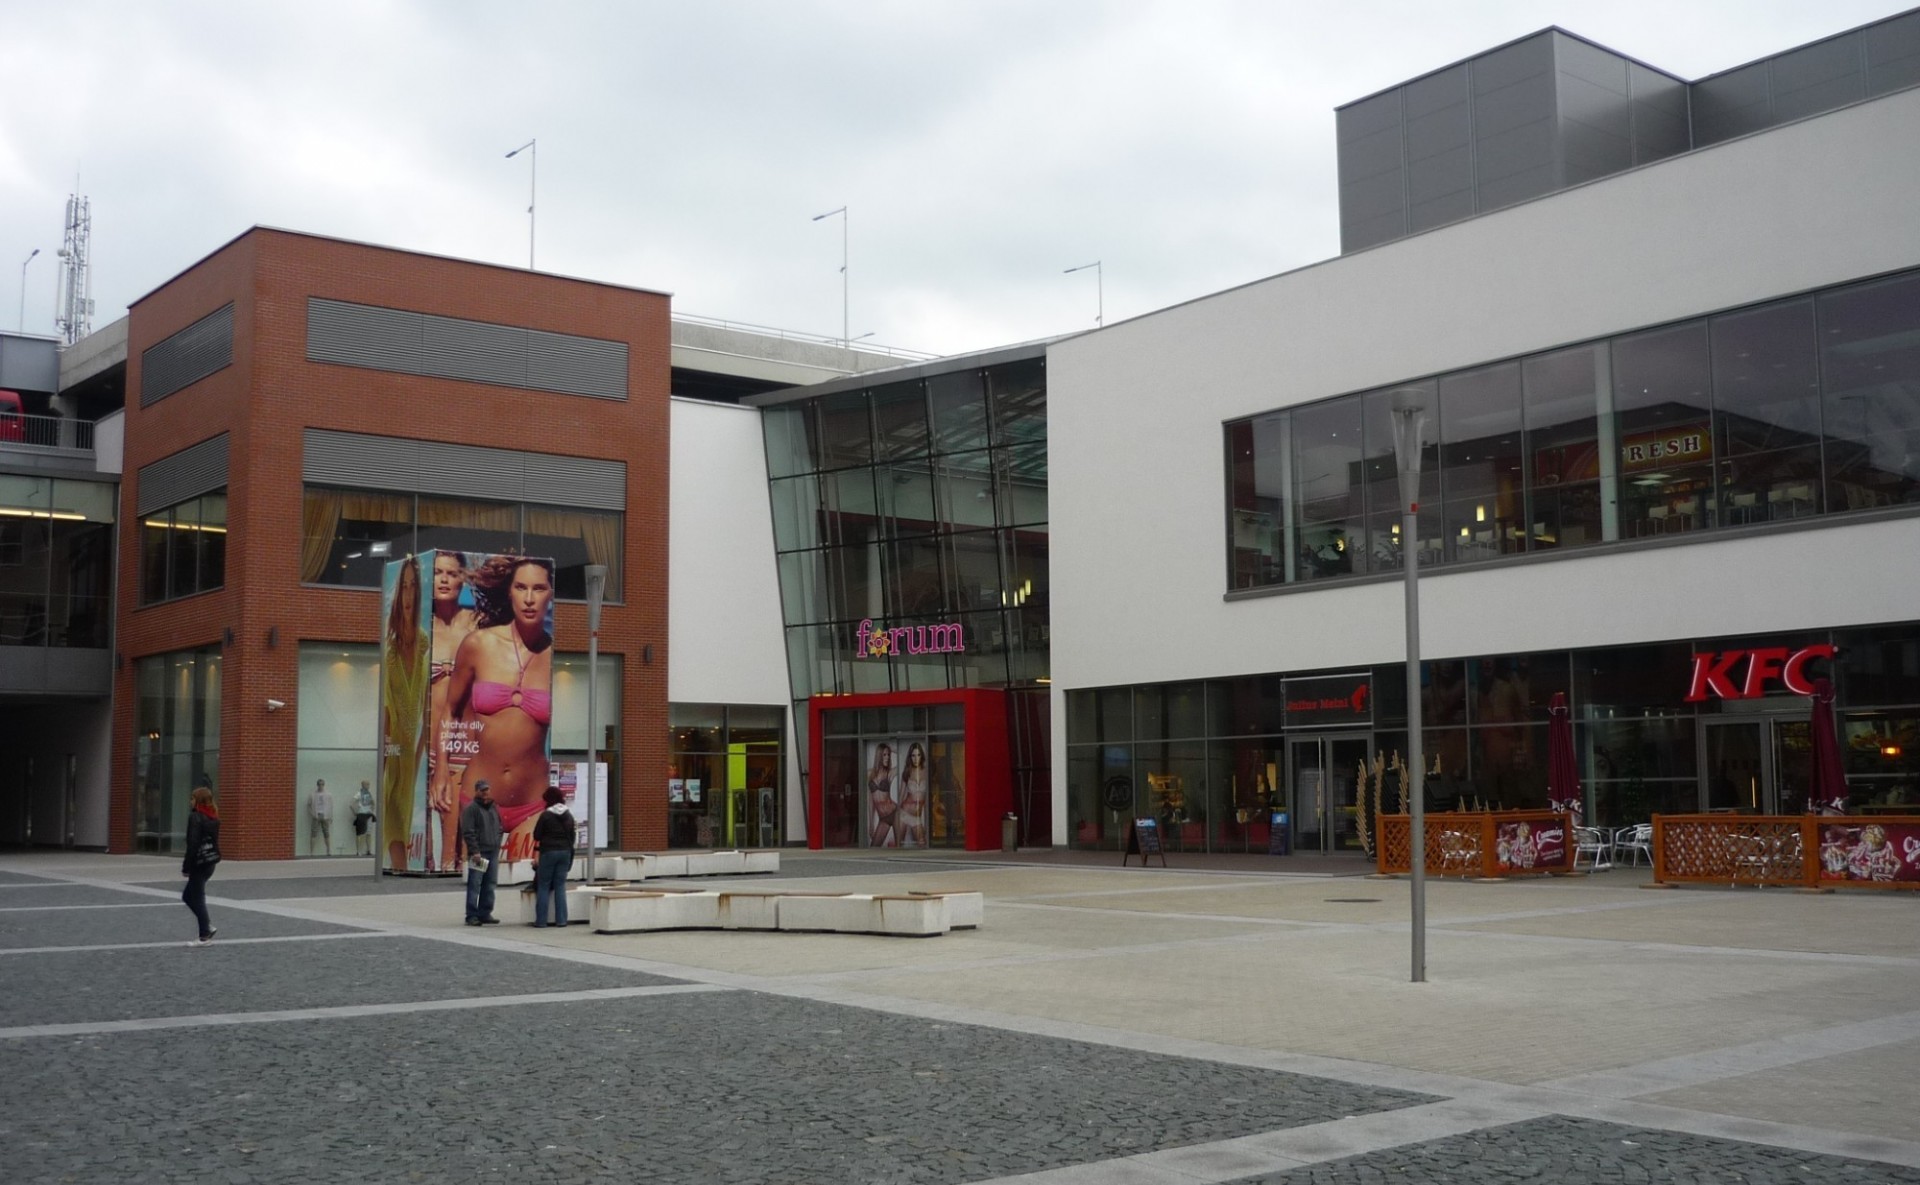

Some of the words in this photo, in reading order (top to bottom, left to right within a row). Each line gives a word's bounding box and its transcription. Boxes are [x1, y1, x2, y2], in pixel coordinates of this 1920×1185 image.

[1622, 434, 1700, 462] RESH
[857, 619, 965, 657] forum
[1684, 644, 1835, 702] KFC
[441, 731, 468, 741] plavek
[470, 720, 484, 732] díly
[440, 740, 462, 753] 149
[463, 741, 480, 754] Kč
